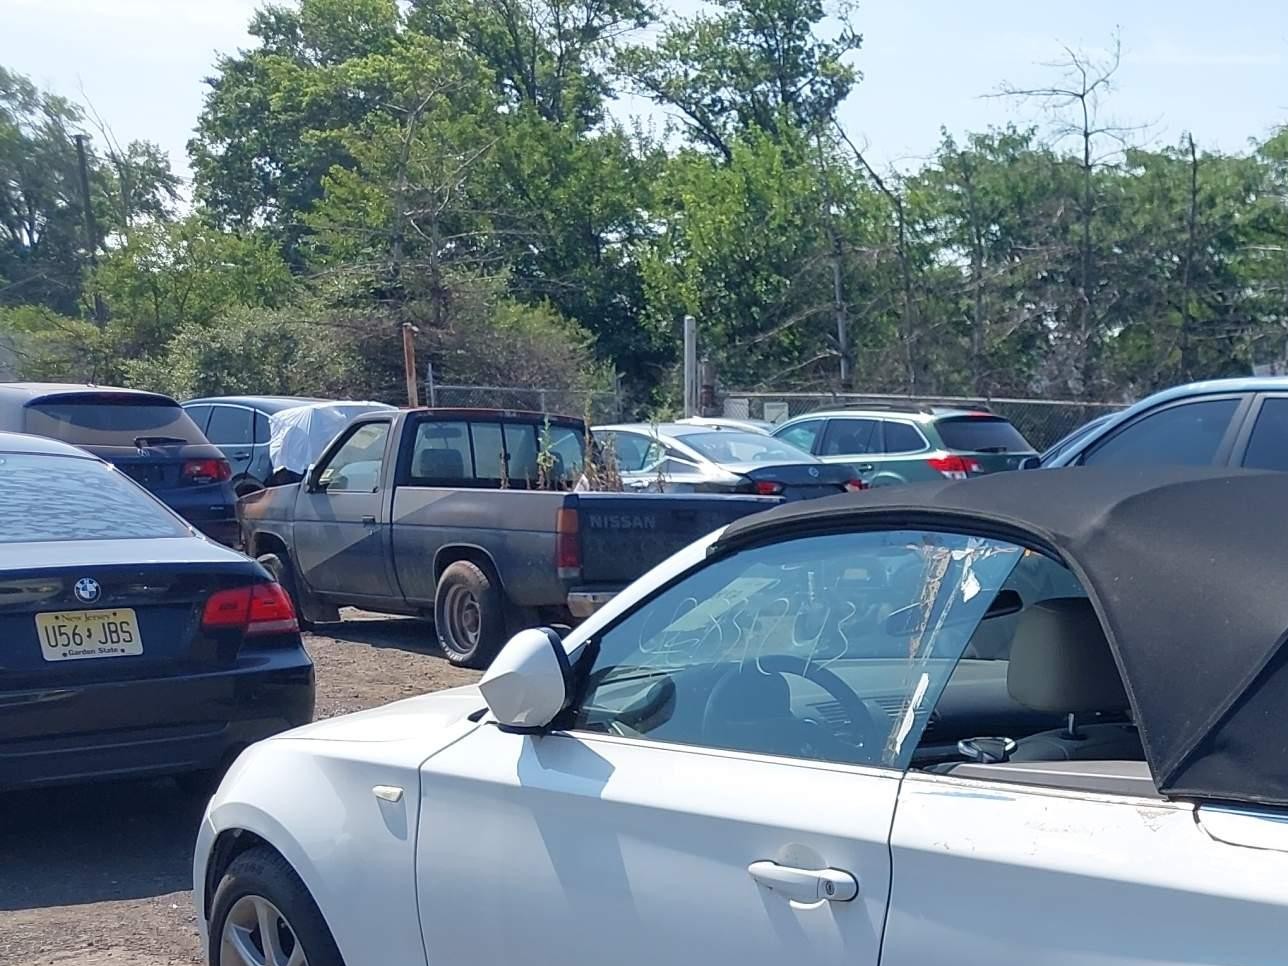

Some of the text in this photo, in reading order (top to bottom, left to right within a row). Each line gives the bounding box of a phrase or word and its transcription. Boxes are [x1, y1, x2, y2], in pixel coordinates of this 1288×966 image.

[589, 514, 657, 529] NISSAN
[84, 613, 111, 623] Jersey
[44, 621, 133, 648] U56 JBS
